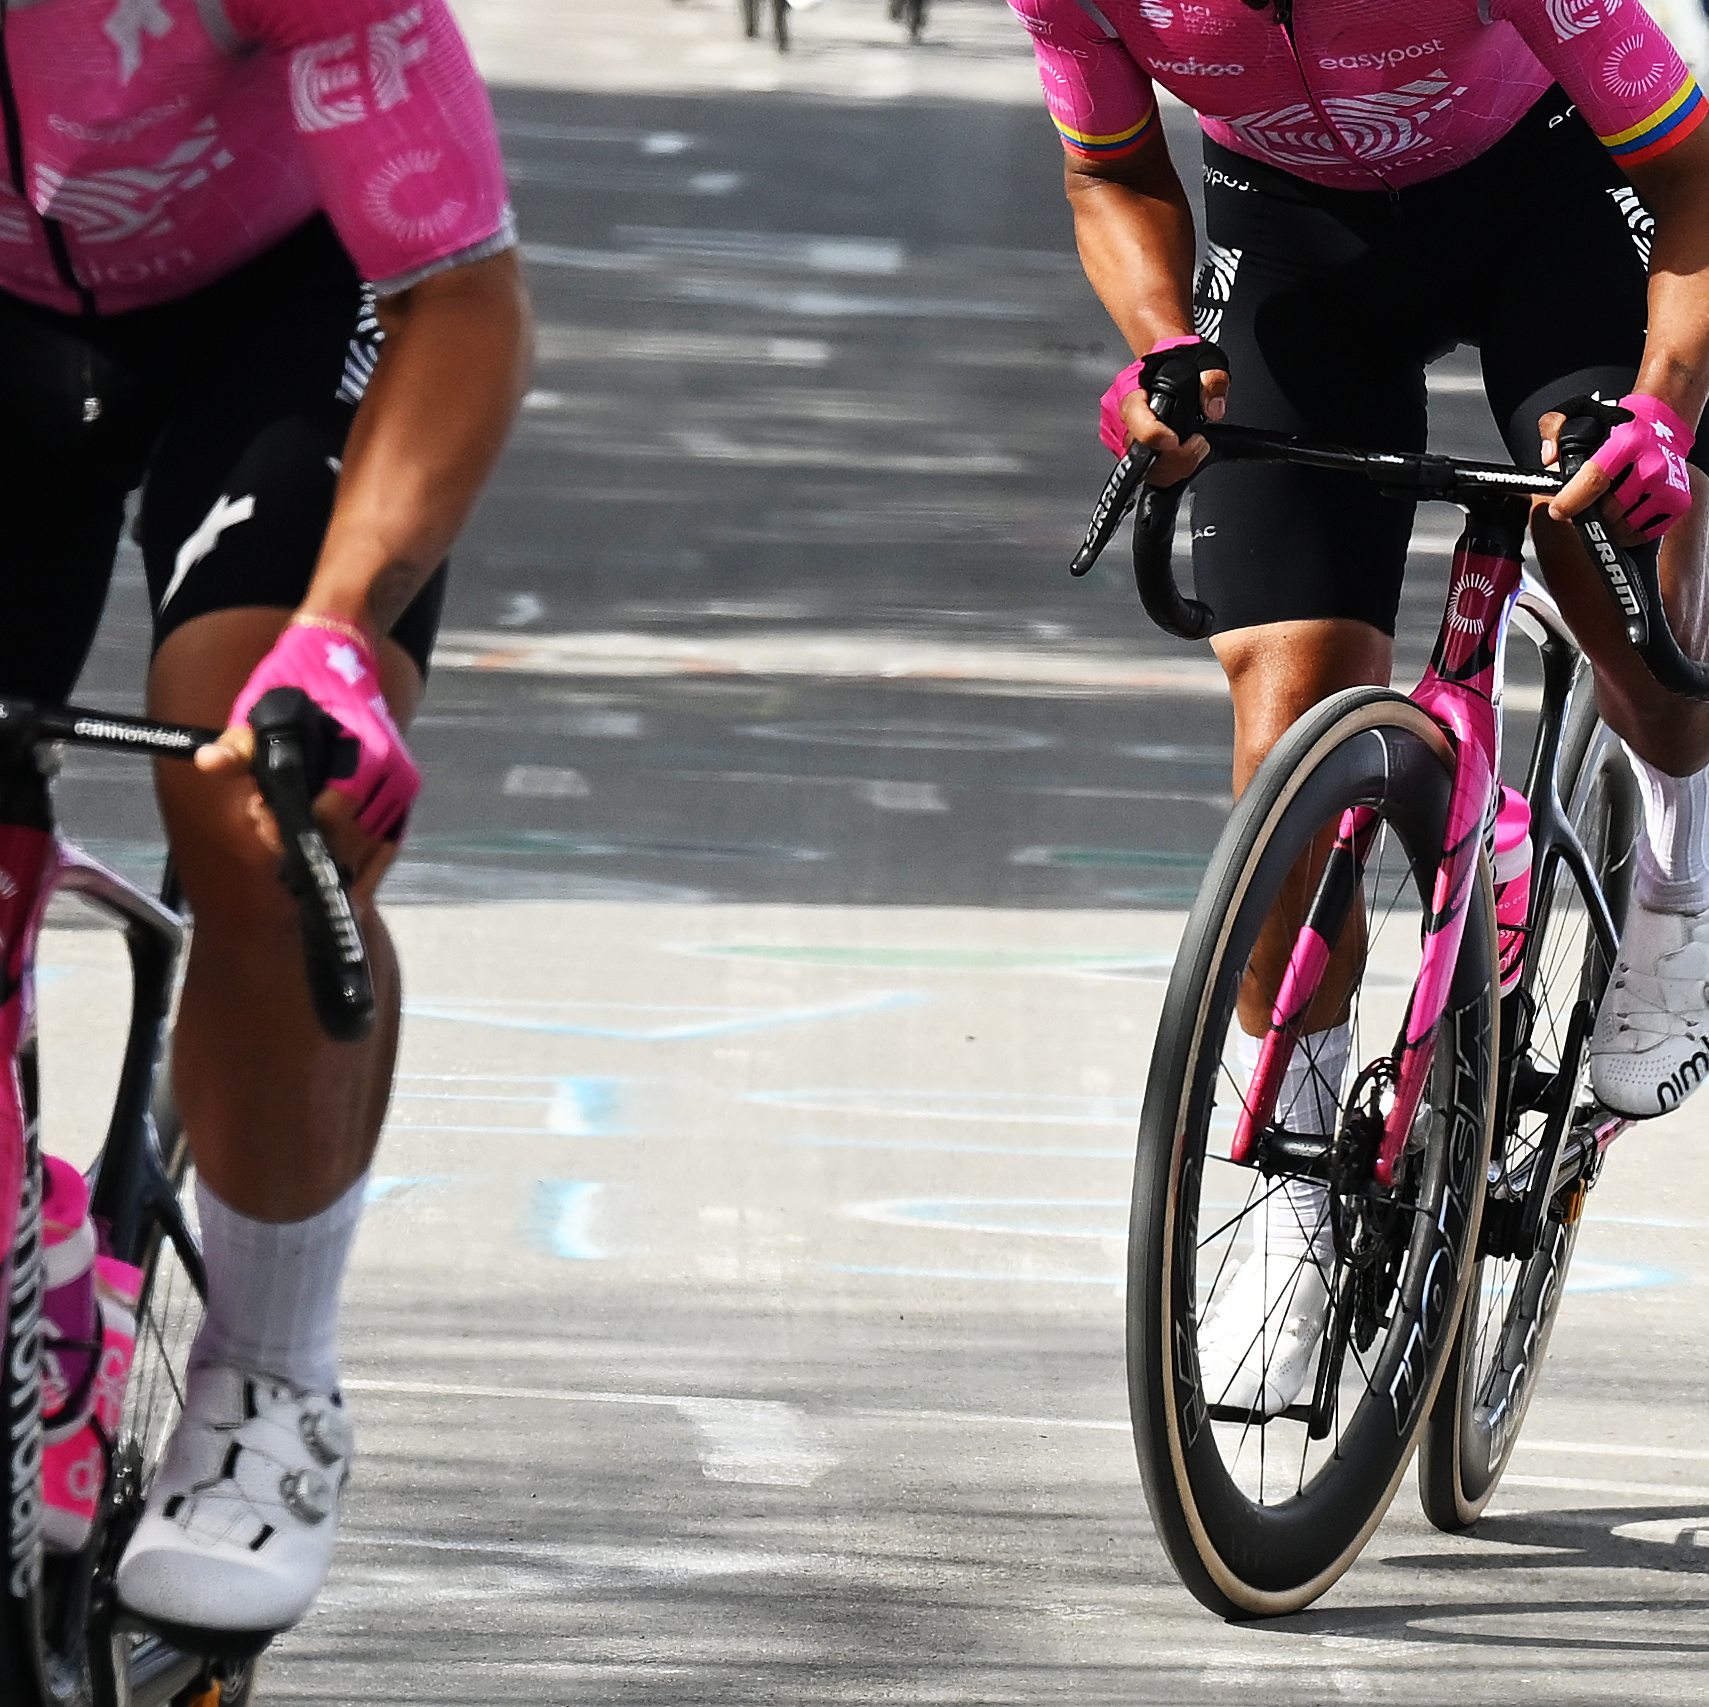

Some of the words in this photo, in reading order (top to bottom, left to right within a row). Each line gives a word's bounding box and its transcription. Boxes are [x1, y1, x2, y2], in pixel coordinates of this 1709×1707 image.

[1179, 2, 1211, 18] UCI
[1146, 56, 1245, 77] wahoo
[1318, 38, 1445, 72] easypost
[1584, 520, 1641, 616] SRAM
